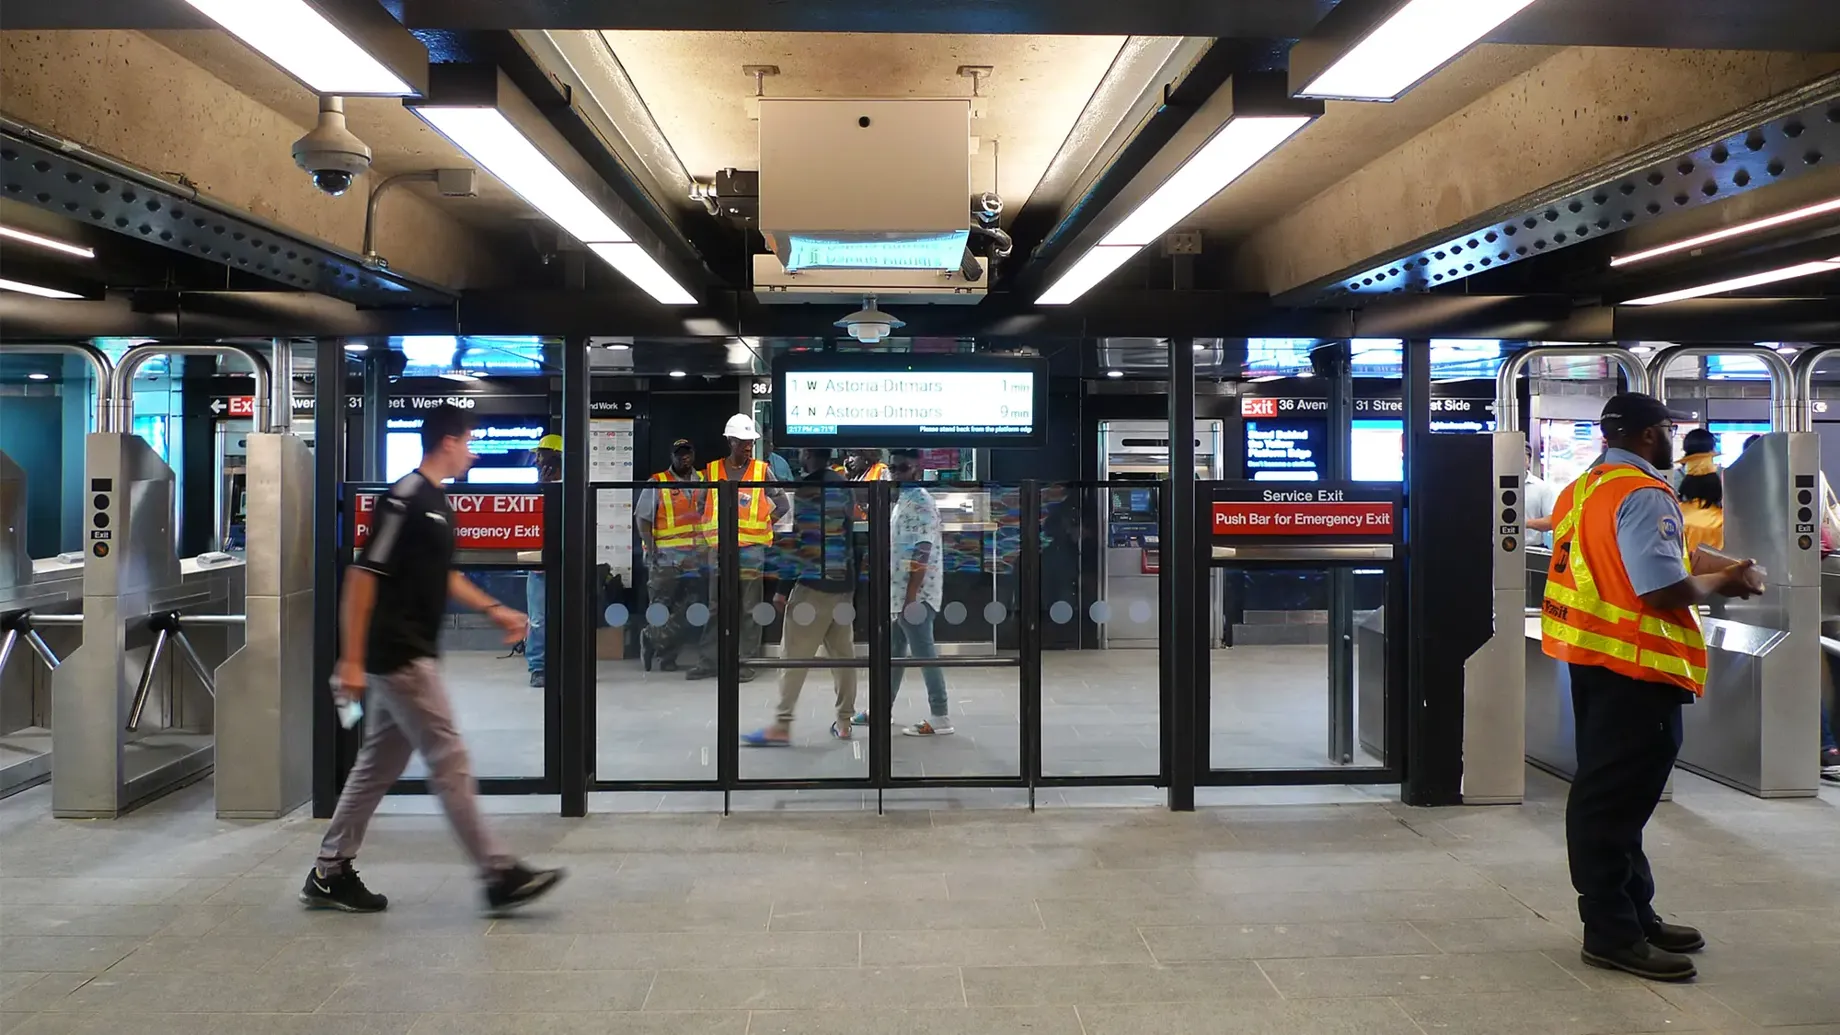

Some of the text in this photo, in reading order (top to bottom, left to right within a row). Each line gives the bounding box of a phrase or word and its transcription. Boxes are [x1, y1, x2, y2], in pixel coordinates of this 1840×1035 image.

[752, 383, 767, 394] 36
[791, 379, 798, 392] 1
[807, 380, 817, 390] W
[1002, 379, 1008, 392] 1
[1010, 383, 1030, 392] min
[348, 397, 363, 408] 31
[412, 397, 443, 409] West
[446, 397, 475, 409] Side
[599, 402, 618, 410] Work
[1242, 400, 1273, 415] Exit
[1278, 399, 1294, 410] 36
[1356, 400, 1369, 411] 31
[1444, 399, 1471, 411] Side
[790, 405, 799, 418] 4
[808, 407, 816, 416] N
[1000, 405, 1009, 418] 9
[1010, 409, 1029, 418] min
[1263, 490, 1344, 502] Service Exit
[493, 496, 539, 513] EXIT
[1215, 513, 1390, 527] Push Bar for Emergency Exit
[94, 531, 108, 539] Exit
[514, 525, 540, 537] Exit
